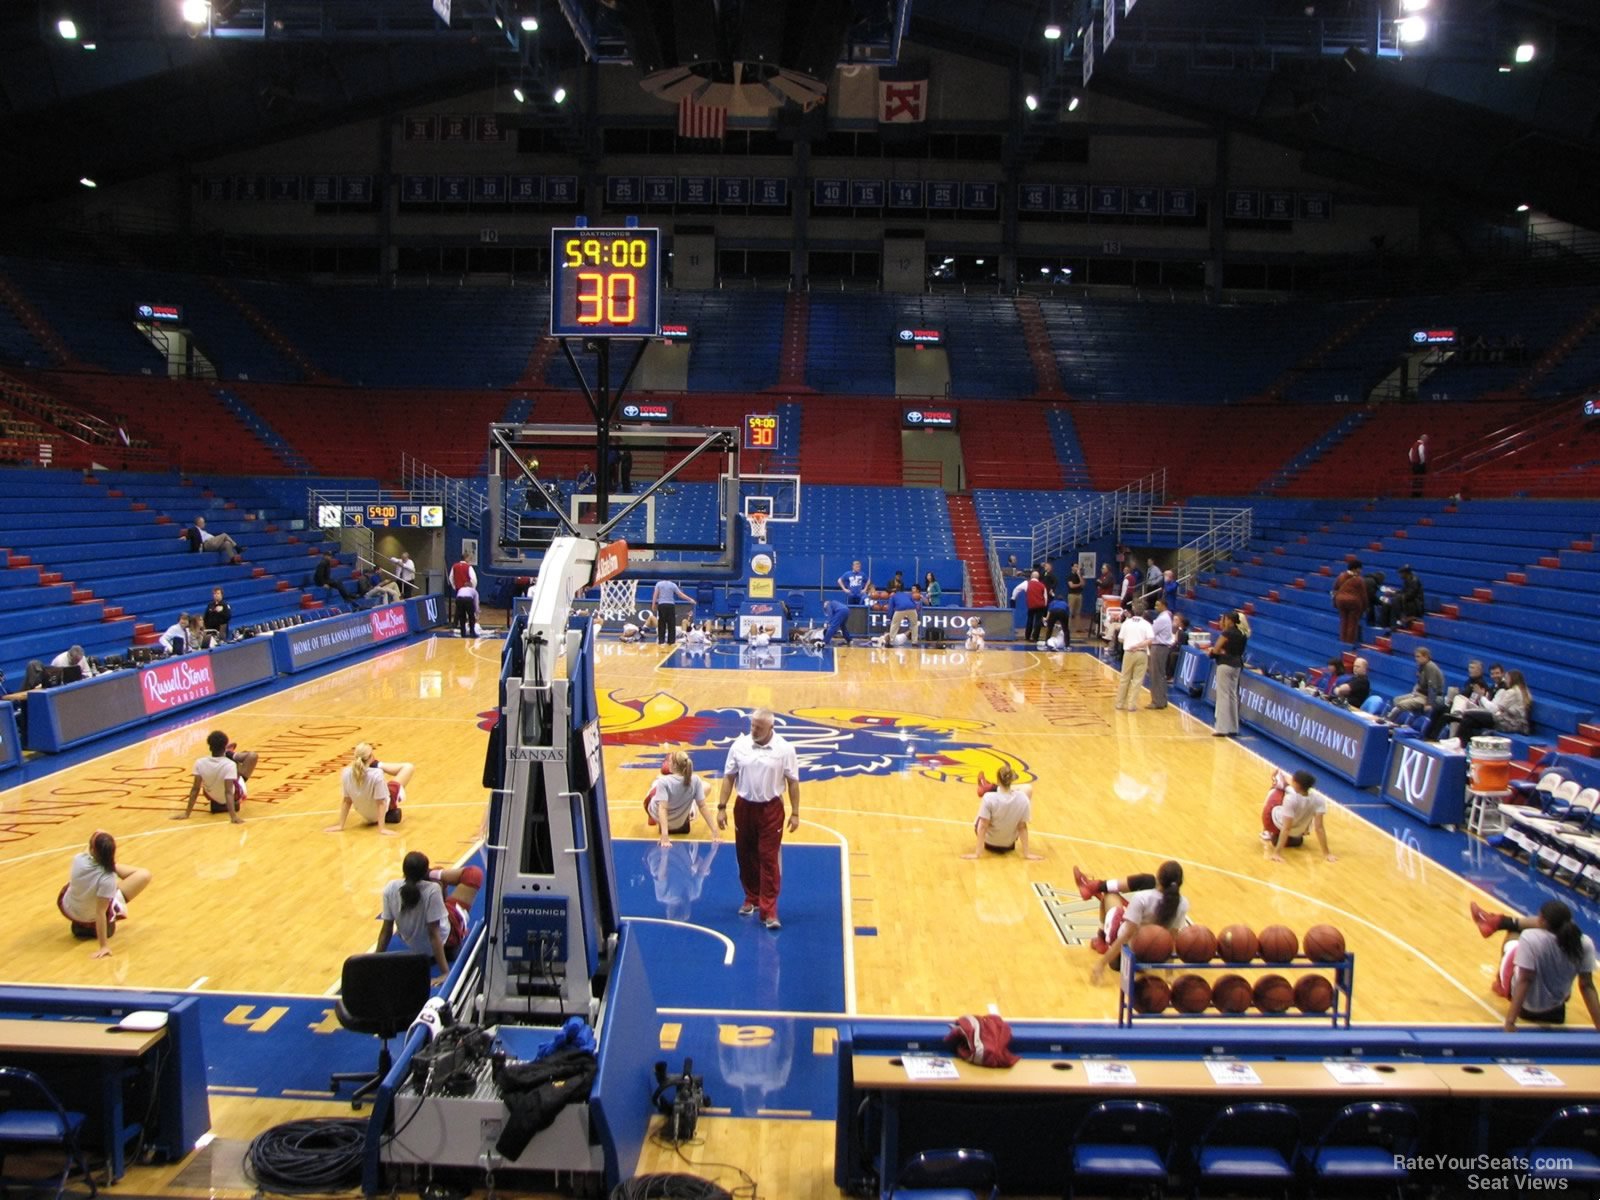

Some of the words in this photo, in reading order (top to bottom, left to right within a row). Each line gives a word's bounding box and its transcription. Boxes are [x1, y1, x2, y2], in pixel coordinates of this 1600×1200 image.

[414, 122, 426, 135] 31
[415, 184, 422, 194] 5
[450, 184, 458, 194] 5
[483, 184, 496, 194] 10
[520, 184, 532, 195] 15
[616, 184, 631, 196] 25
[654, 185, 666, 196] 13
[688, 185, 703, 196] 32
[727, 186, 740, 197] 13
[764, 186, 776, 197] 15
[824, 187, 839, 198] 40
[862, 188, 874, 199] 15
[900, 189, 912, 200] 14
[935, 189, 950, 201] 25
[975, 191, 984, 202] 11
[1062, 193, 1077, 204] 34
[1139, 195, 1146, 207] 4
[1173, 197, 1185, 208] 10
[566, 240, 647, 268] 59:00
[577, 273, 636, 322] 30
[749, 418, 775, 428] 59:00
[753, 428, 772, 445] 30
[370, 507, 394, 517] 59:00
[411, 514, 417, 525] 0
[425, 598, 437, 623] KU
[293, 640, 311, 655] HOME
[312, 637, 319, 649] OF
[320, 635, 331, 647] THE
[331, 629, 349, 644] KANSAS
[349, 623, 372, 640] JAYHAWKS
[1180, 651, 1197, 685] KU
[144, 666, 183, 702] Russell
[181, 662, 210, 690] Stover
[170, 686, 210, 705] CANDIES
[1246, 692, 1263, 713] THE
[1264, 698, 1300, 730] KANSAS
[1299, 712, 1358, 760] JAYHAWKS
[509, 749, 561, 760] KANSAS
[1395, 745, 1435, 805] KU
[503, 908, 566, 916] DAKTRONICS
